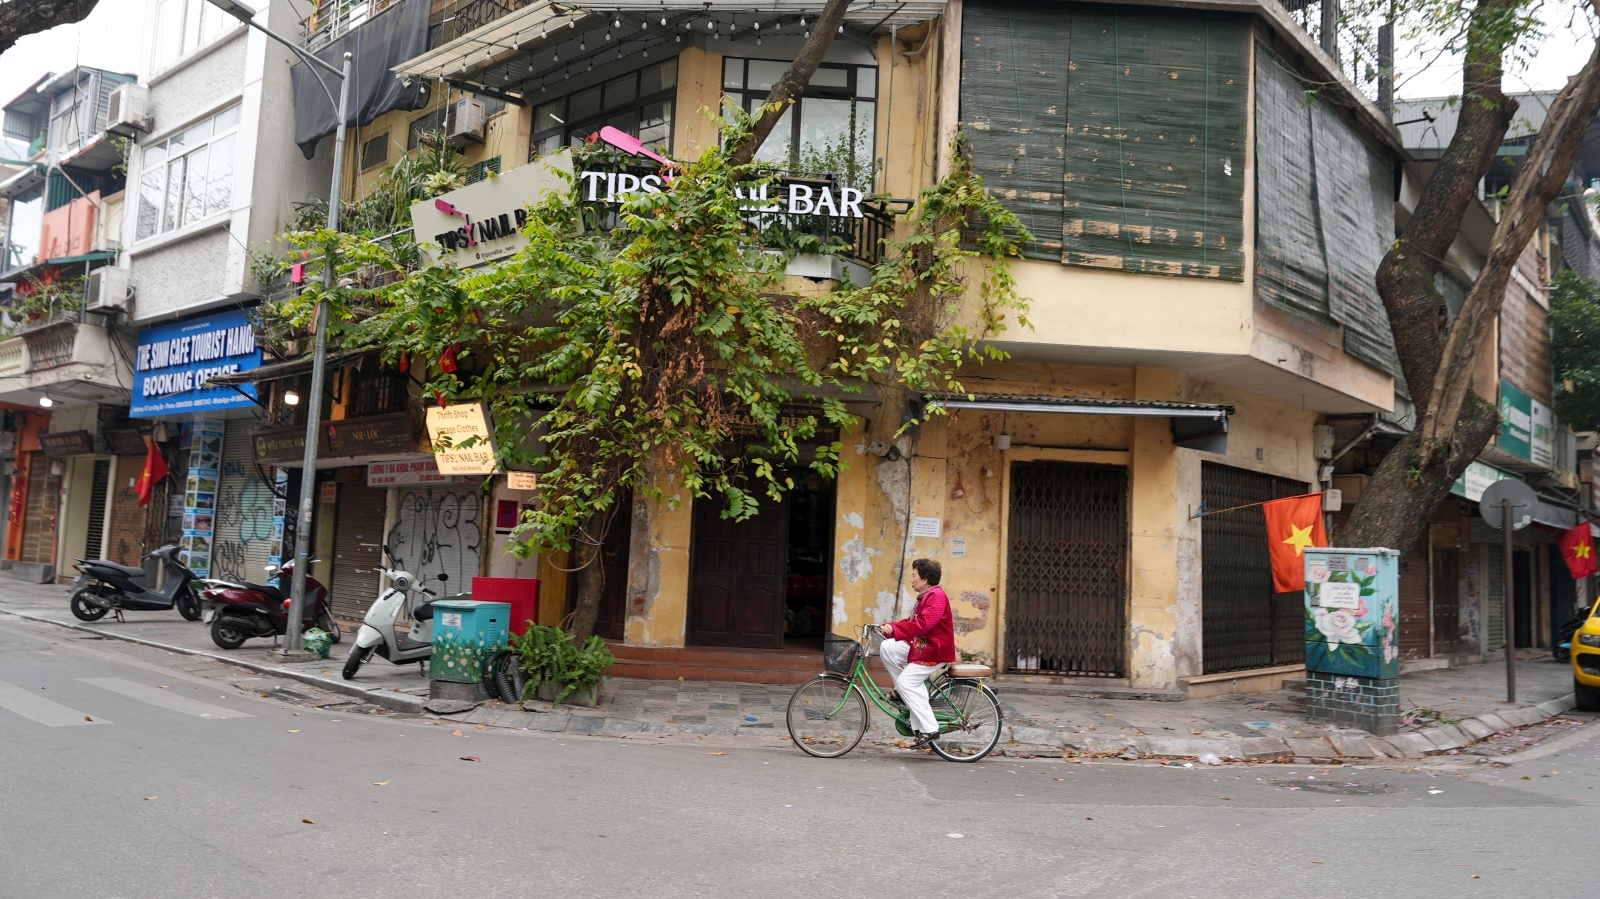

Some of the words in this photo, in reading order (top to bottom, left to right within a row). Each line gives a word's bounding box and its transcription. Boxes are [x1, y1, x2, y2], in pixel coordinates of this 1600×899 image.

[581, 171, 672, 205] TIPS
[788, 184, 864, 218] BAR
[435, 222, 477, 255] TIPSY
[477, 213, 516, 243] NAIL
[137, 344, 151, 371] THE
[150, 340, 170, 369] SINH
[169, 336, 191, 366] CAFE
[190, 329, 227, 362] TOURIST
[143, 370, 193, 397] BOOKING
[436, 411, 453, 420] Thrift
[453, 410, 469, 420] Shop
[781, 414, 818, 428] BÌN
[456, 424, 479, 433] Clothes
[458, 452, 474, 462] NAIL
[474, 452, 489, 462] BAR
